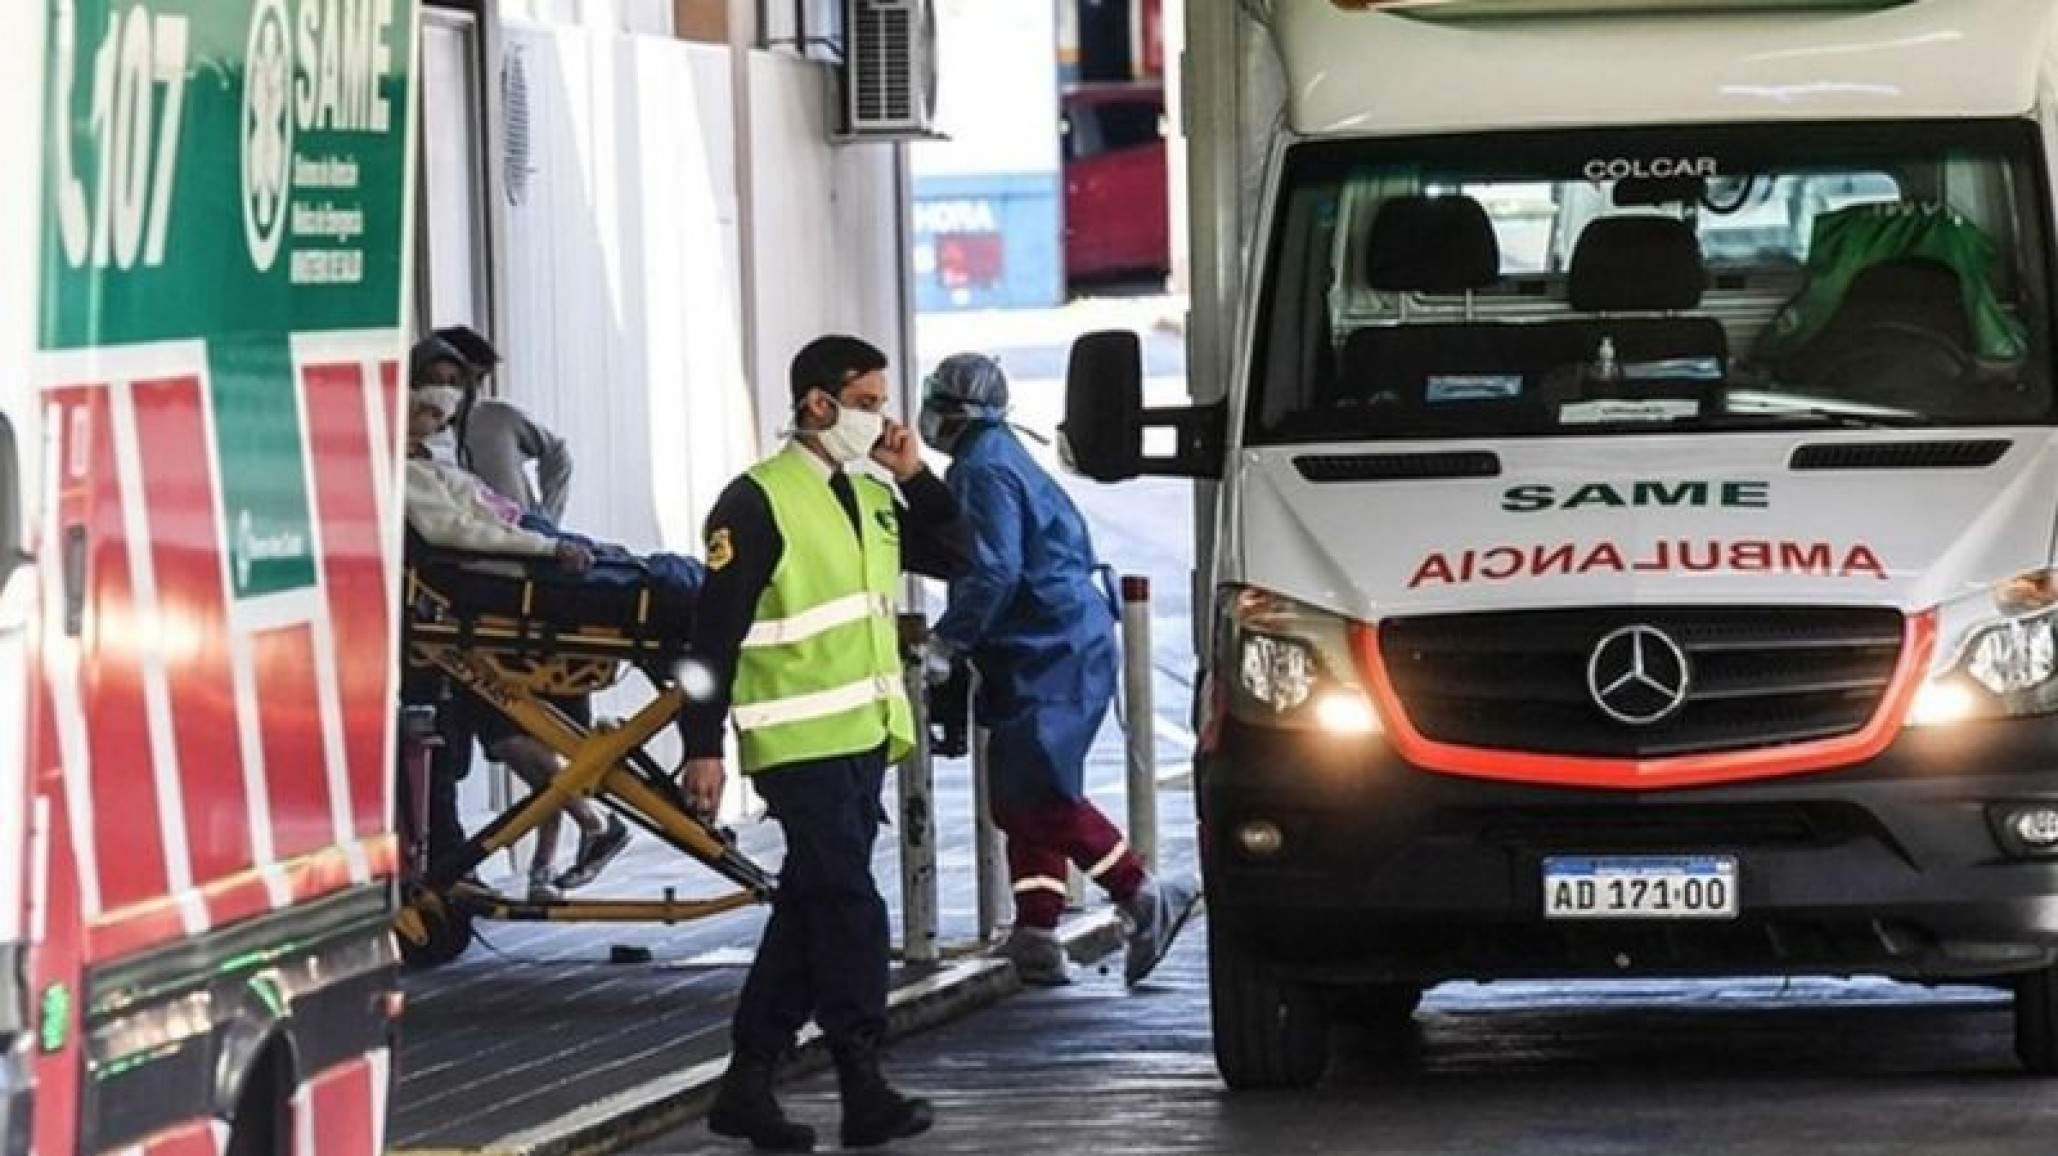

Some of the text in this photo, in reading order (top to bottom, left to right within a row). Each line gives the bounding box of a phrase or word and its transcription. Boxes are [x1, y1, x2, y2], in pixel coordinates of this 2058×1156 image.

[295, 0, 391, 131] SAME
[90, 5, 188, 268] 107
[1584, 156, 1716, 179] COLCAR
[1501, 481, 1770, 512] SAME
[1554, 879, 1596, 909] AD
